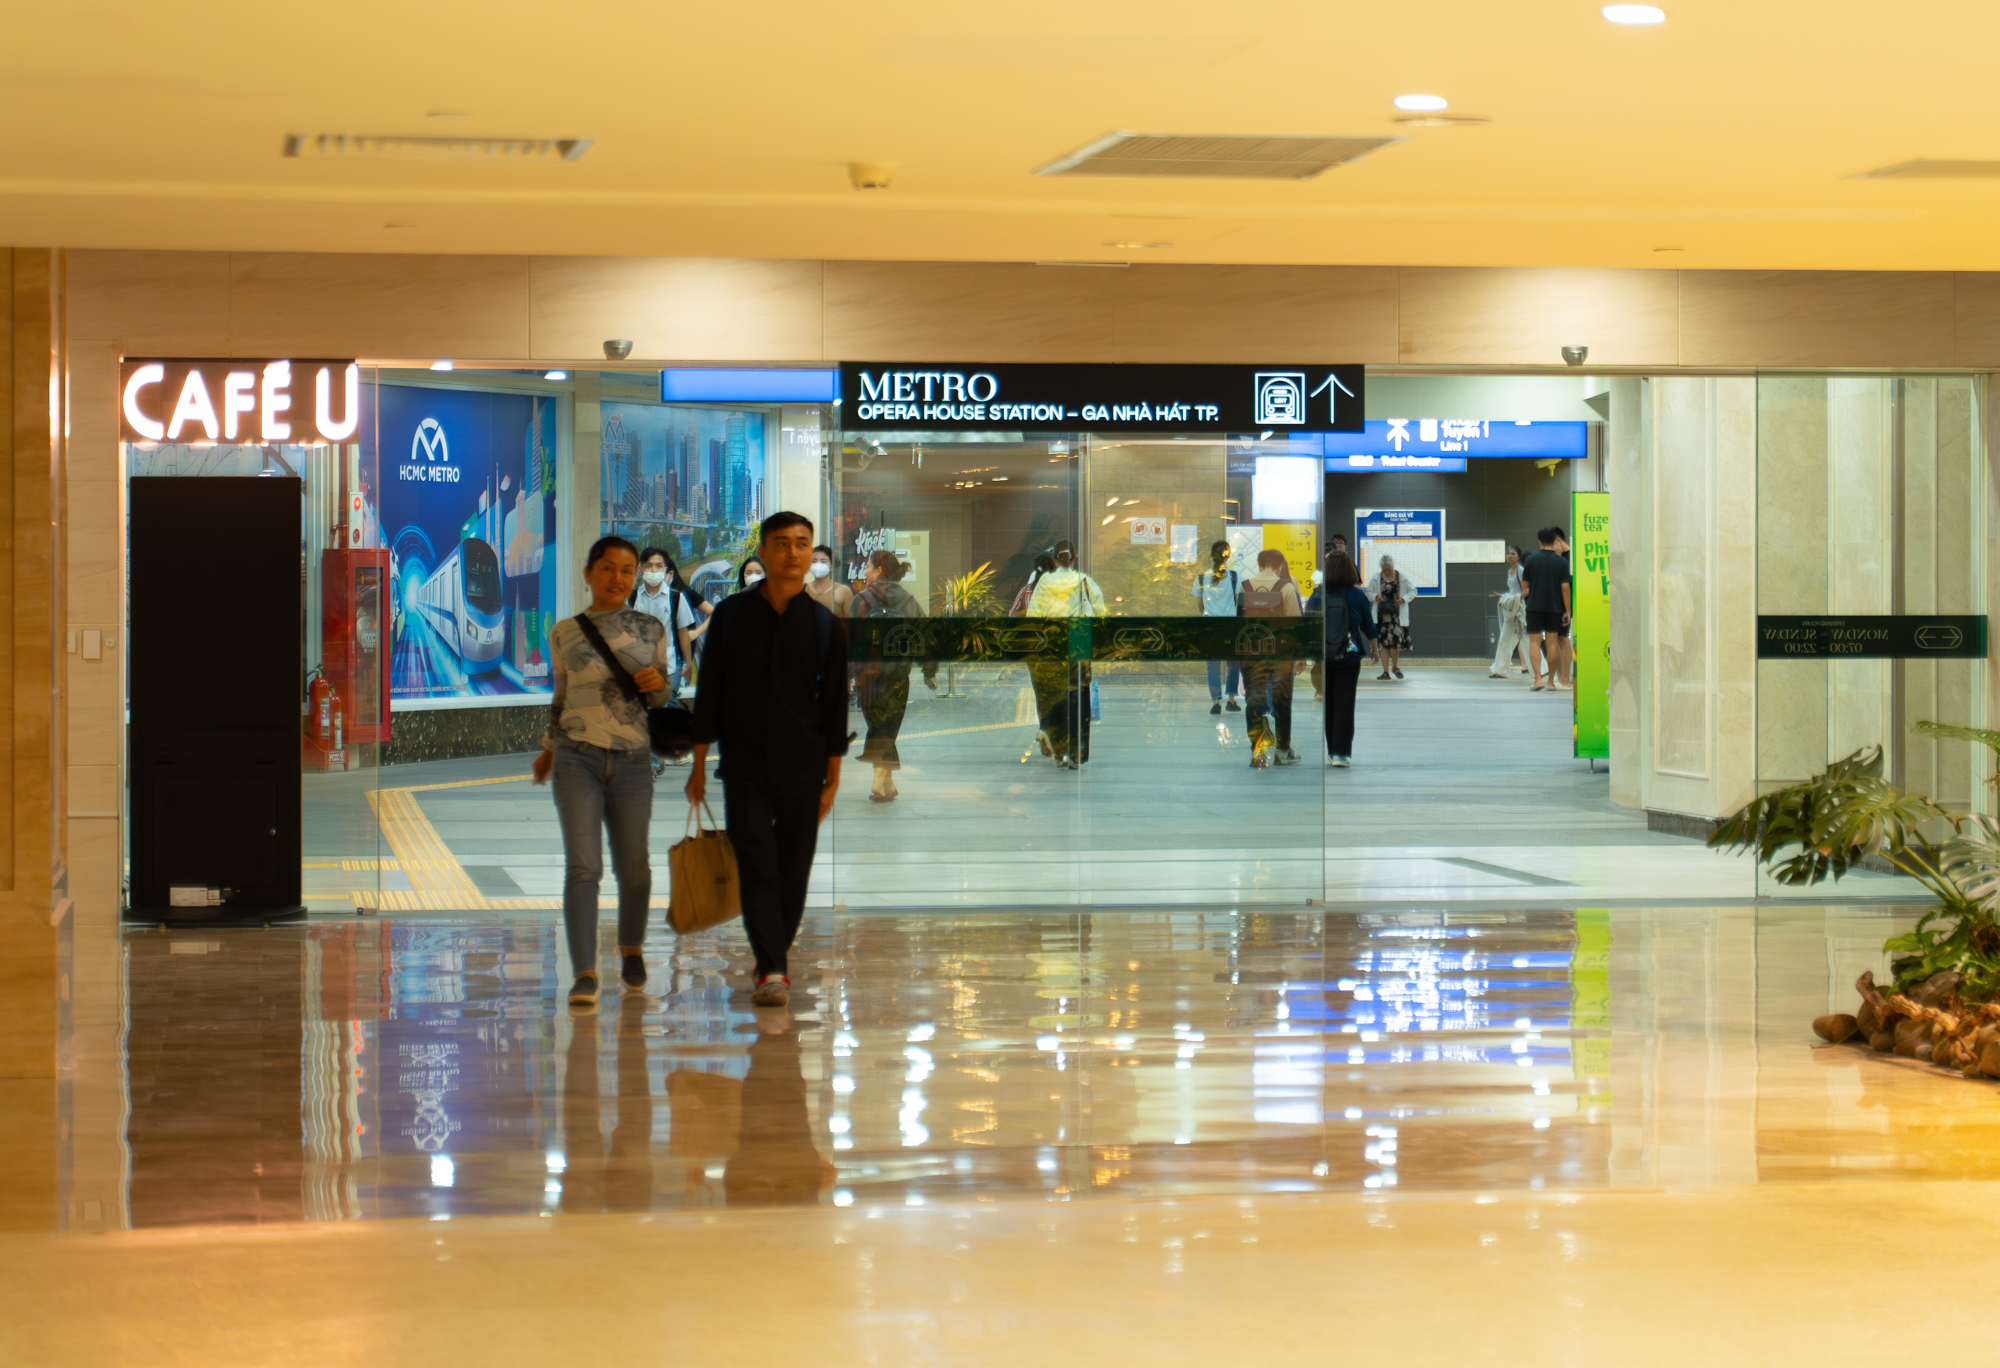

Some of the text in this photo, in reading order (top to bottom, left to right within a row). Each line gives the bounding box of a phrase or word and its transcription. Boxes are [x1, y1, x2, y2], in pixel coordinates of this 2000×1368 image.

[858, 372, 998, 401] METRO
[123, 360, 358, 440] CAFÉ U
[857, 404, 920, 420] OPERA
[924, 405, 986, 420] HOUSE
[989, 405, 1063, 420] STATION
[1082, 405, 1108, 421] GA
[1113, 402, 1152, 421] NHÀ
[1156, 402, 1190, 421] HÁT
[1195, 405, 1219, 421] TP.
[1463, 440, 1468, 451] 1
[400, 465, 460, 483] HCMC METRO
[1583, 513, 1609, 524] fuze
[1583, 524, 1602, 532] tea
[1307, 541, 1310, 551] 1
[1306, 561, 1312, 570] 2
[1306, 580, 1312, 589] 3
